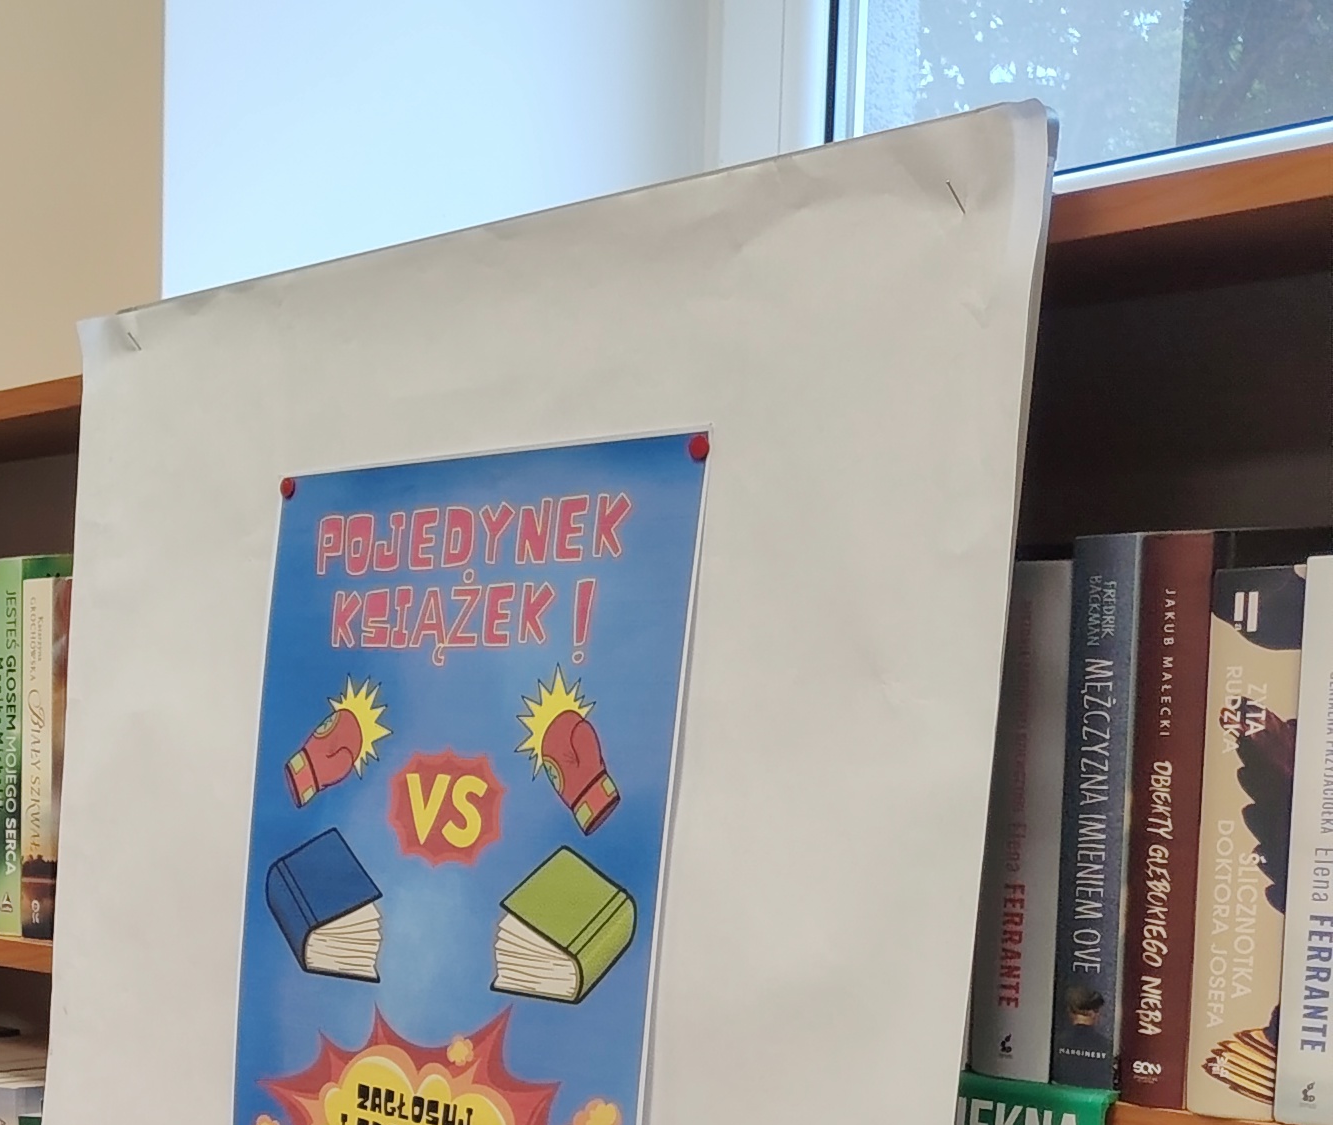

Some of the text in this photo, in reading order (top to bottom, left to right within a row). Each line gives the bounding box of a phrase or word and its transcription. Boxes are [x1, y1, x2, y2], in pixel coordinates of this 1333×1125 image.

[316, 492, 634, 576] POJEDYNEK
[331, 573, 554, 666] KSIĄŻEK
[1085, 575, 1103, 646] BACKMAN
[1100, 581, 1118, 639] FREDRIK
[1159, 588, 1177, 737] JAKUB MAŁECKI
[5, 590, 19, 875] JESTEŚ MOJEGO SERCA
[1220, 665, 1244, 755] RUDZKA
[1244, 683, 1269, 737] ZYTA
[404, 772, 488, 850] VS
[1071, 658, 1117, 974] MĘŻCZYZNA IMIENIEM OVE
[997, 882, 1026, 1009] FERRANTE
[1136, 761, 1174, 1036] OBIEKTY GŁĘBOKIEGO NIEBA
[1206, 819, 1234, 1028] DOKTORA JOSEFA
[1230, 852, 1267, 999] ŚLICZNOTKA
[1299, 914, 1333, 1053] FERRANTE
